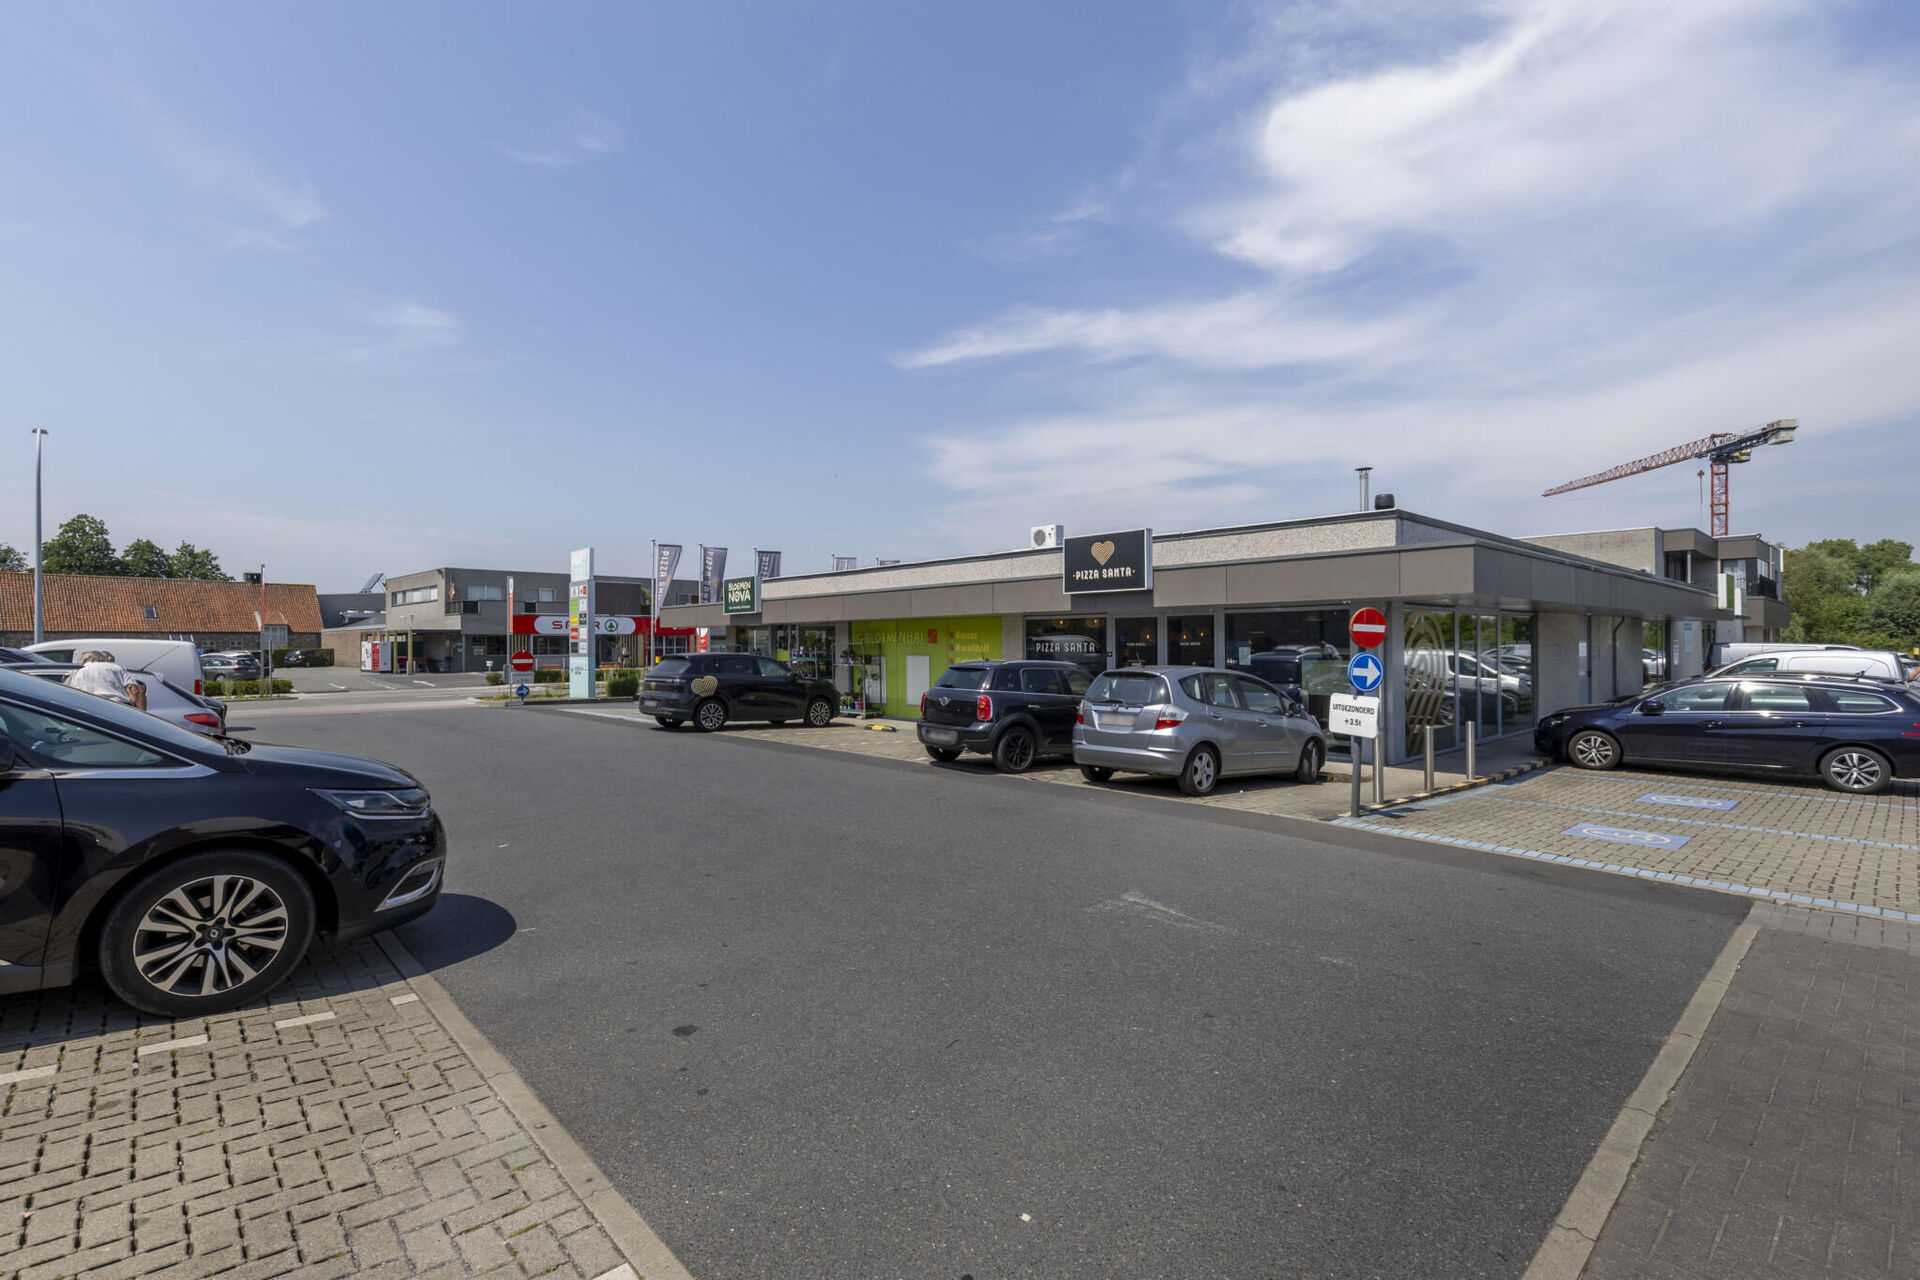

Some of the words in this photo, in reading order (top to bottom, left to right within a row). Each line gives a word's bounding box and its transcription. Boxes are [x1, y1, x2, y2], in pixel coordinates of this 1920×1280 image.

[1075, 569, 1099, 580] PIZZA
[1102, 566, 1132, 578] SANTA
[728, 581, 751, 591] BLOEMEN
[728, 590, 751, 603] NOVA
[1035, 642, 1060, 652] PIZZA
[1064, 642, 1095, 652] SANTA
[1332, 703, 1375, 715] UITGEZONDERD
